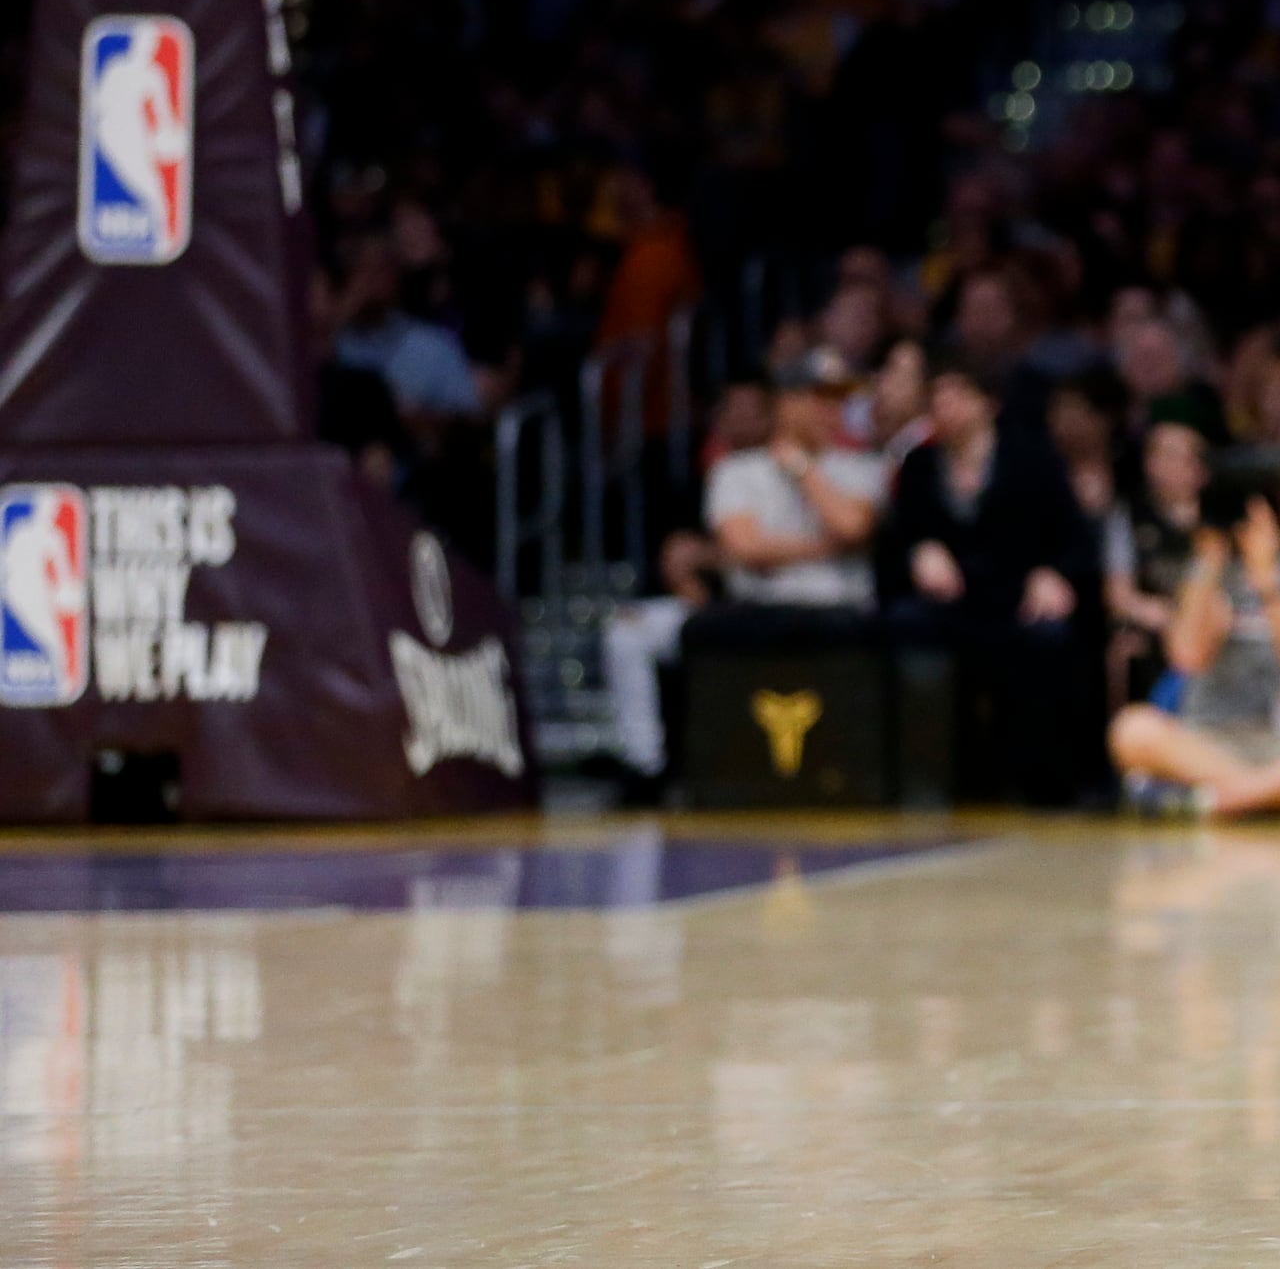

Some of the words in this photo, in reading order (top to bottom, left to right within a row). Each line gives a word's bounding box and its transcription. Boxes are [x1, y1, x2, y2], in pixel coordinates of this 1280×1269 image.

[92, 486, 187, 553] THIS
[189, 484, 237, 567] IS
[94, 565, 190, 621] WHY
